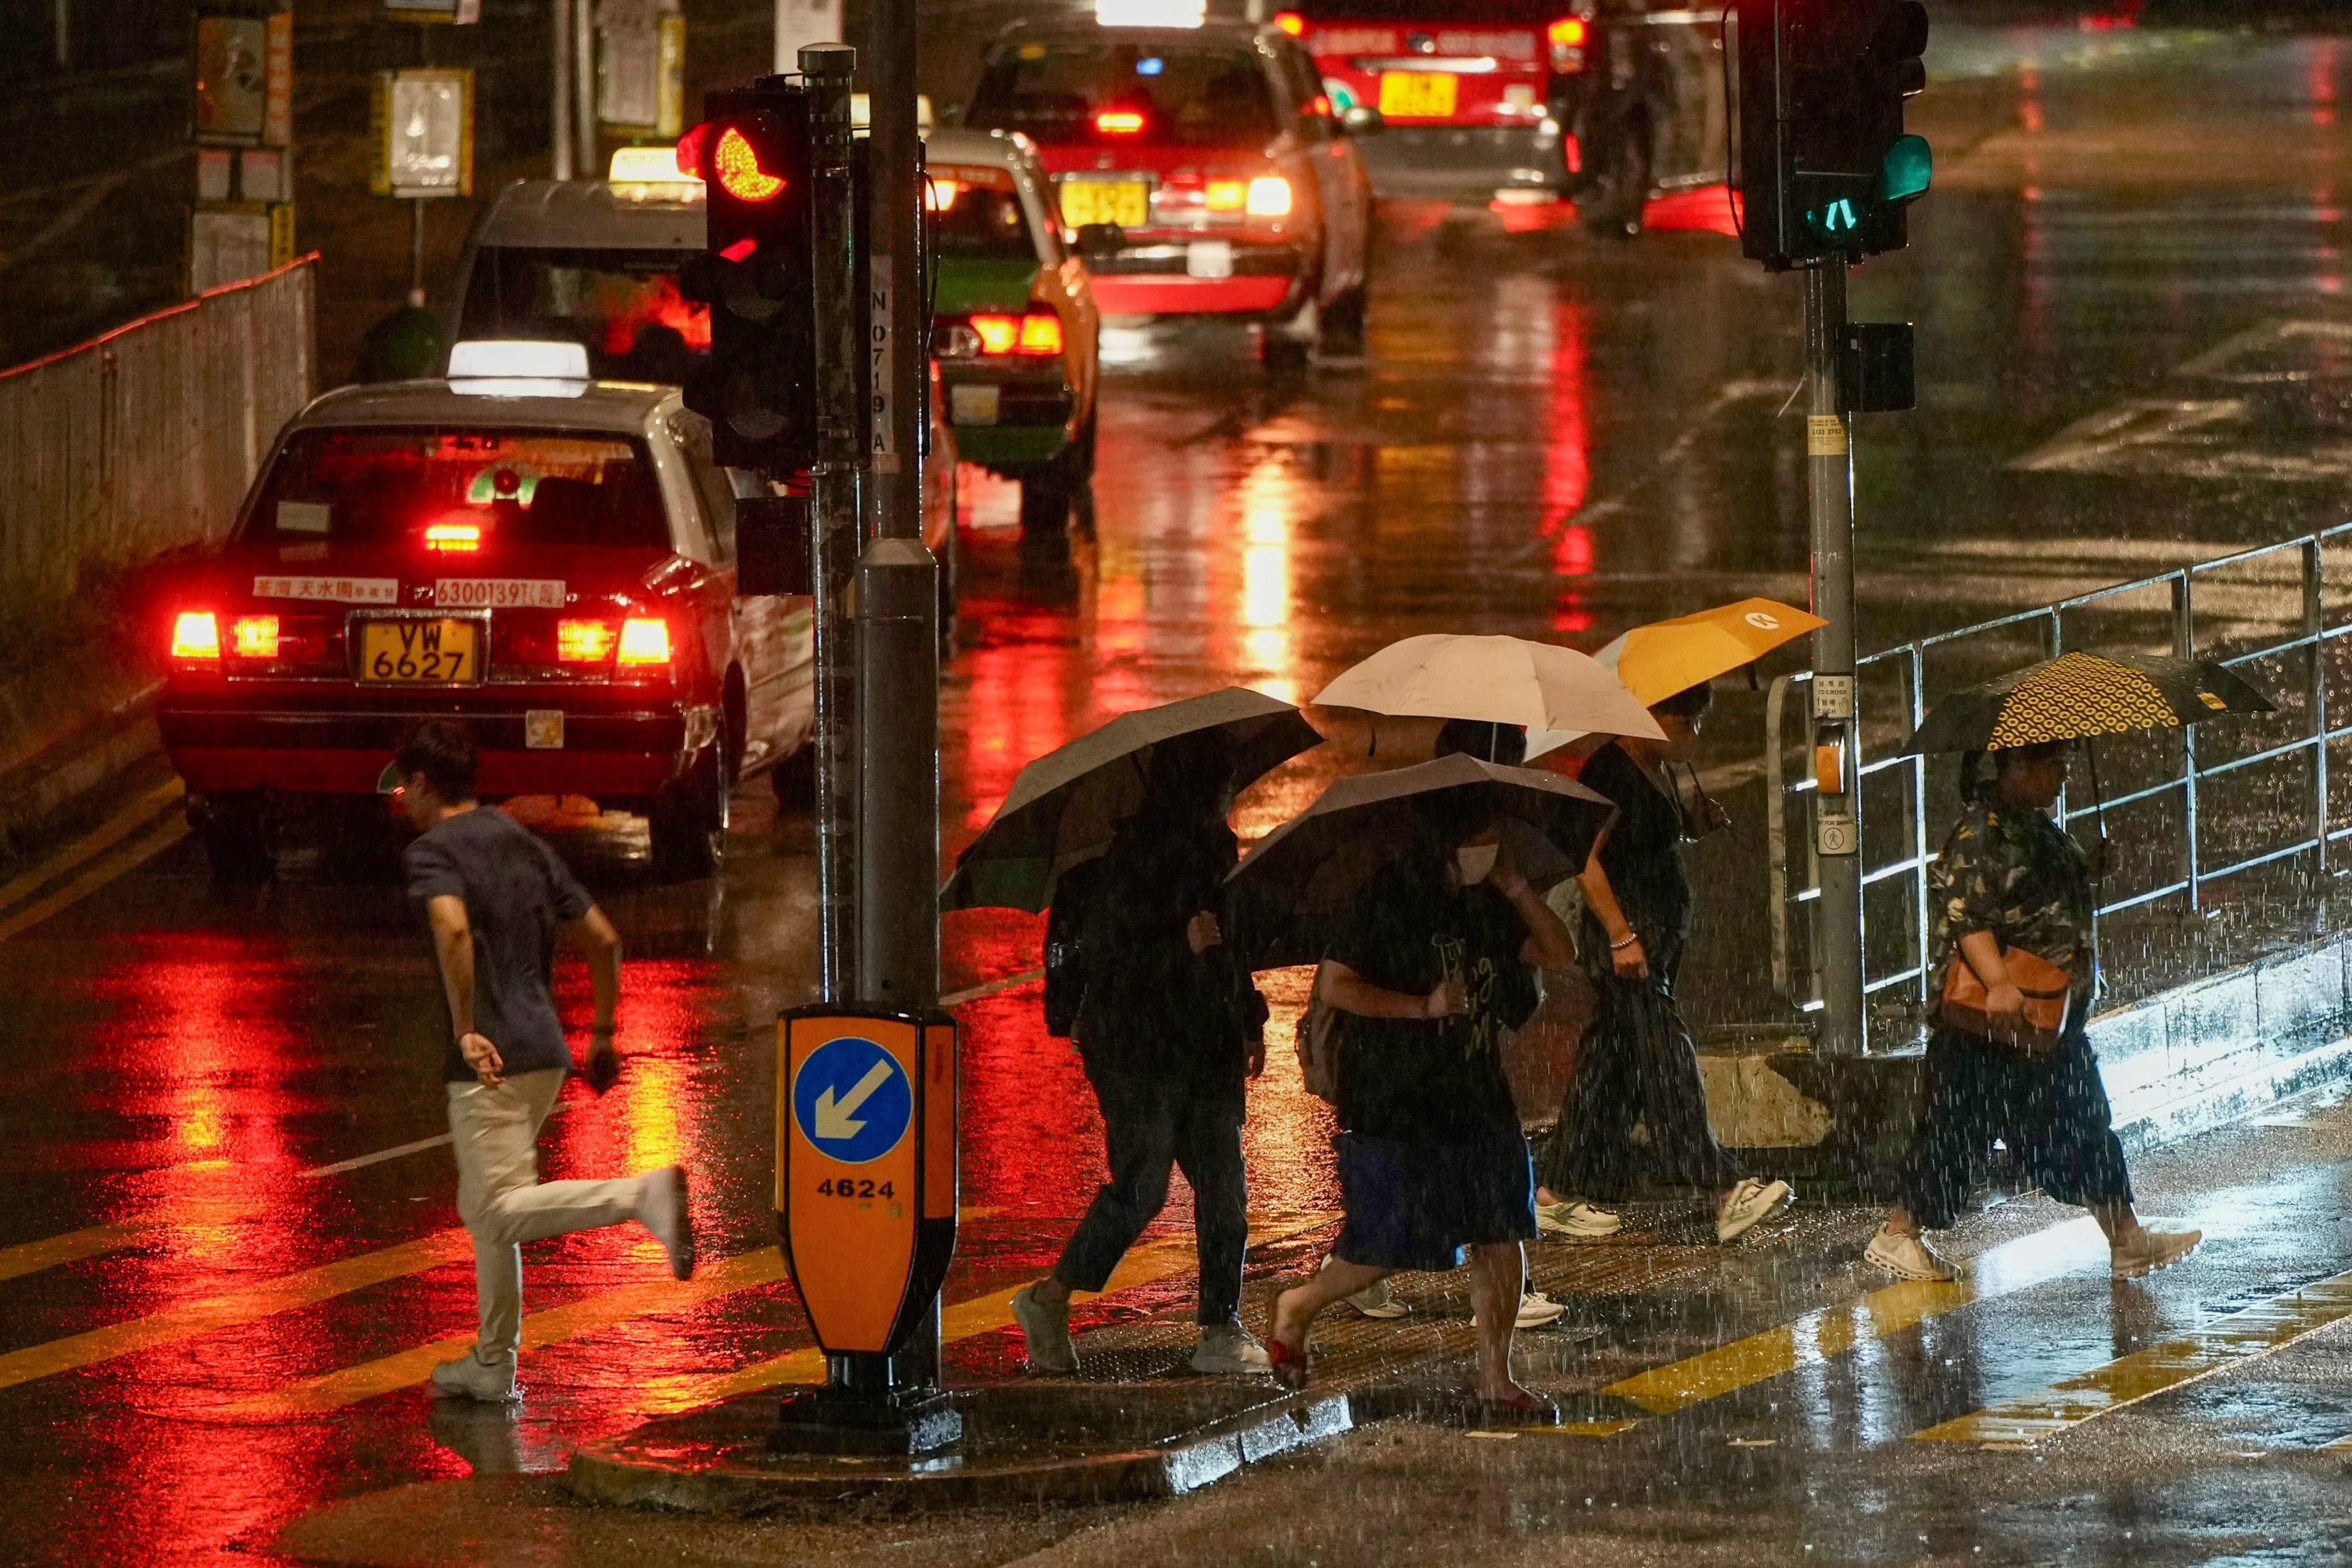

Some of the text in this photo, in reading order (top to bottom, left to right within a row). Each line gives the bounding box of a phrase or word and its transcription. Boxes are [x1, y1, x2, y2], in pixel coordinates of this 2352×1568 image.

[399, 623, 441, 651] VW
[374, 651, 465, 679] 6627
[817, 1179, 894, 1199] 4624
